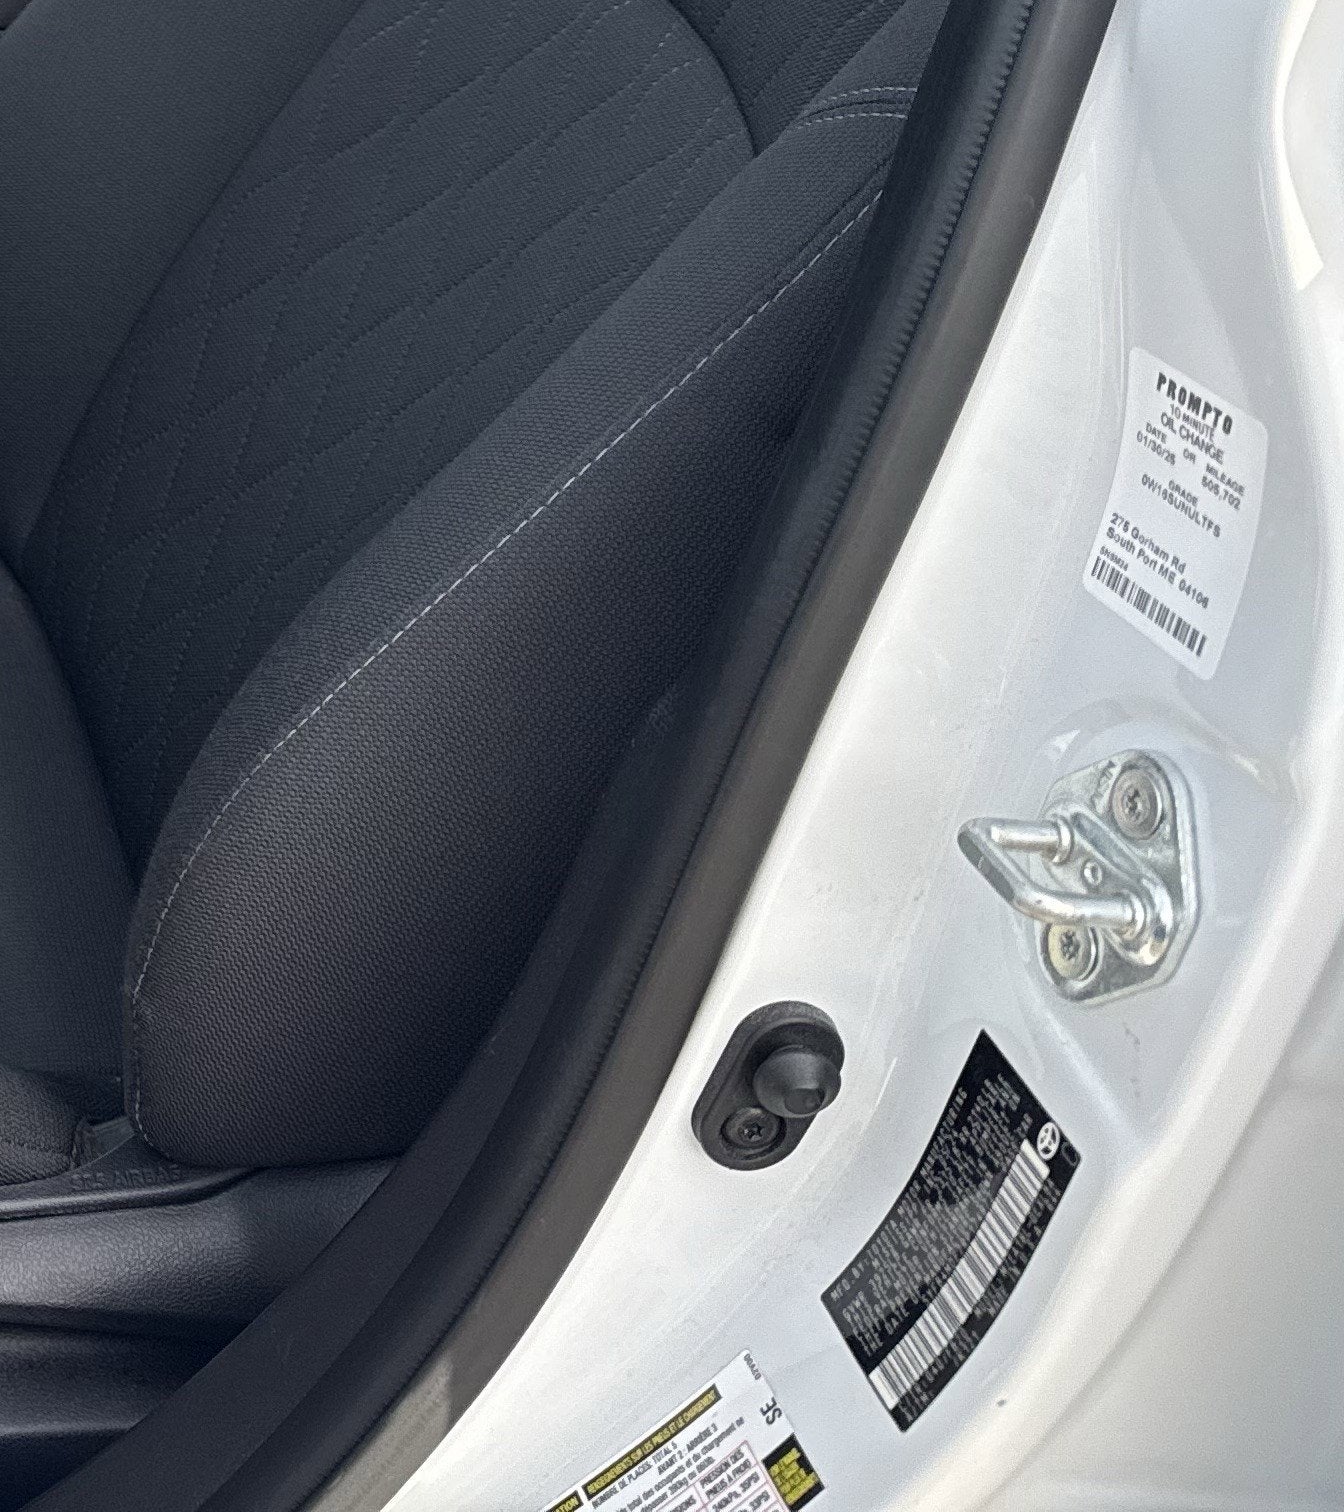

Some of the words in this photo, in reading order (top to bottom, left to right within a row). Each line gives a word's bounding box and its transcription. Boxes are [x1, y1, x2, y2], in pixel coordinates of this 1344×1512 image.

[1155, 372, 1235, 435] PROMPTO
[1159, 411, 1176, 434] OIL
[1178, 423, 1224, 465] CHANGE
[1181, 411, 1216, 442] MINUTE
[1144, 421, 1166, 444] DATE
[1182, 447, 1197, 464] OR
[1204, 461, 1245, 497] MILEAGE
[1168, 478, 1198, 506] GRADE
[1105, 525, 1136, 555] South
[1136, 546, 1159, 571] Port
[1157, 563, 1176, 585] ME
[1130, 525, 1170, 563] Gorham
[1170, 554, 1186, 575] Rd
[758, 1396, 784, 1426] SE
[616, 1478, 627, 1489] DE
[650, 1444, 672, 1464] TOTAL
[655, 1453, 679, 1475] AVANT
[676, 1449, 684, 1459] 2
[727, 1446, 744, 1464] DES
